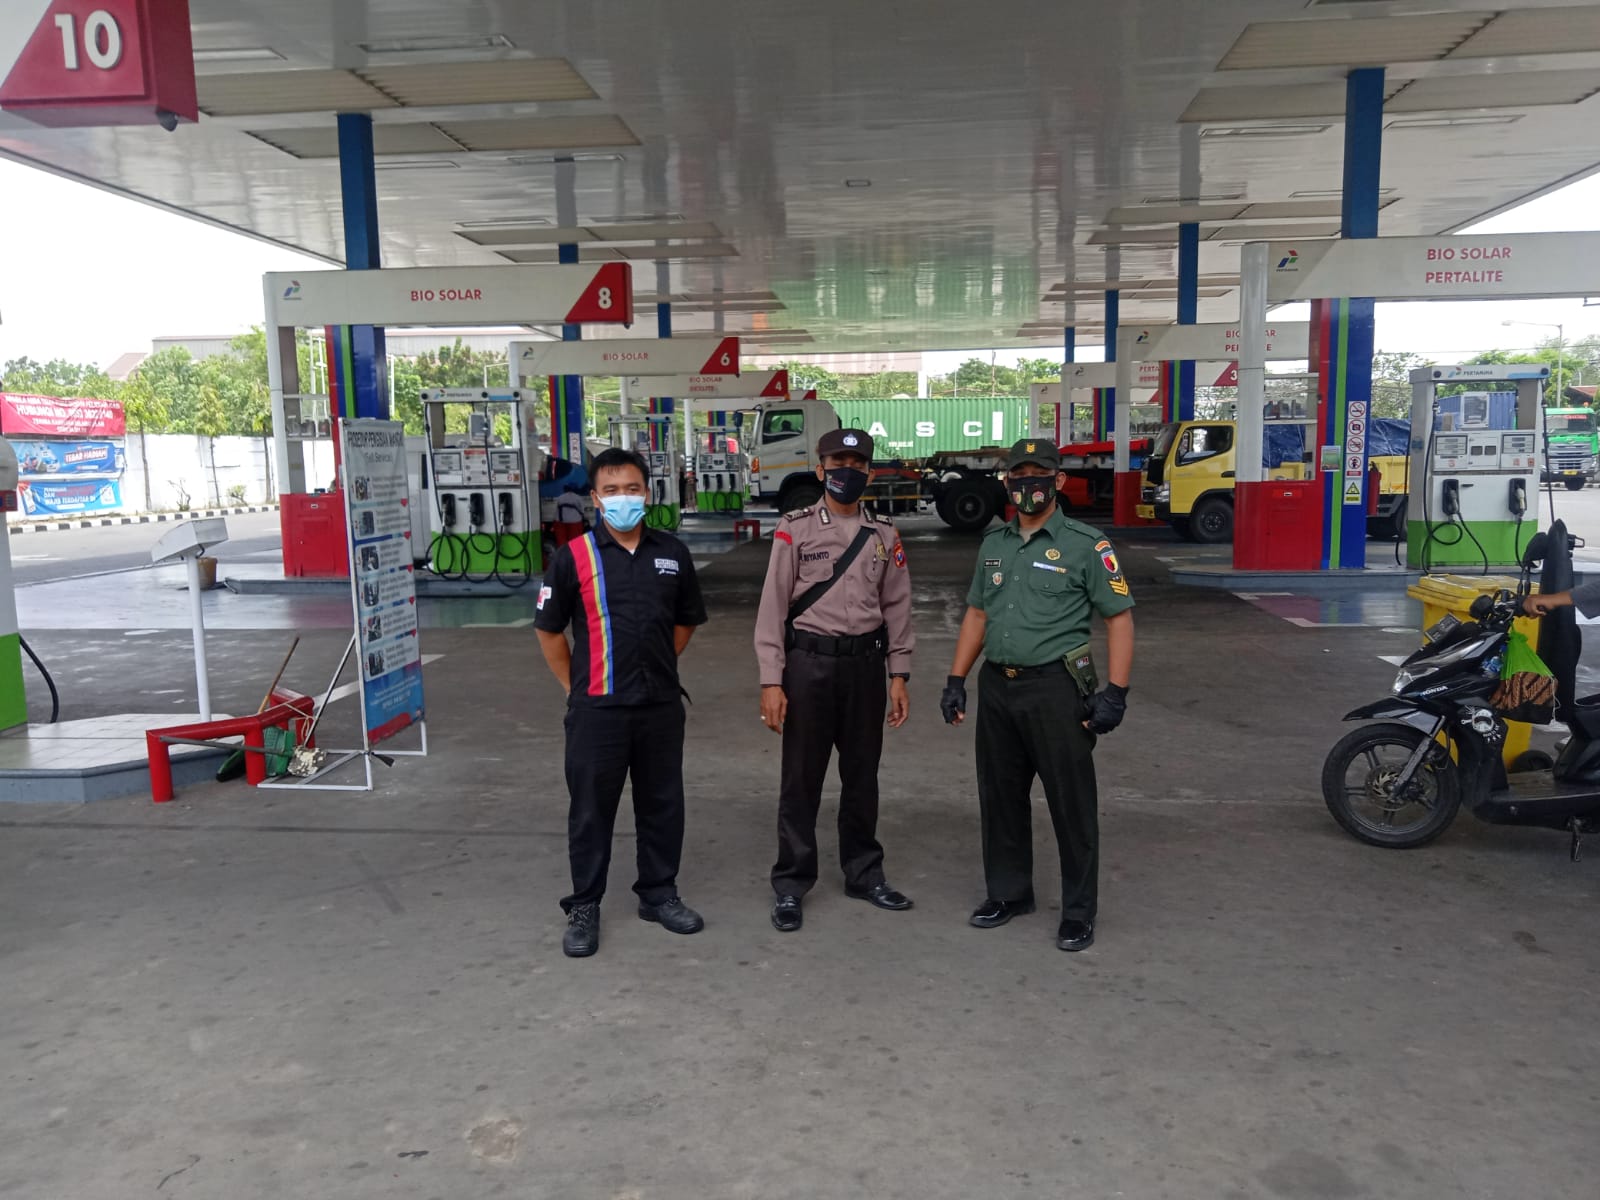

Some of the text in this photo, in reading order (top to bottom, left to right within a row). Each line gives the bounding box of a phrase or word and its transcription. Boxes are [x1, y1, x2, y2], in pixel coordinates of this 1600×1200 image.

[54, 10, 122, 71] 10
[1427, 247, 1511, 261] BIO SOLAR
[1425, 270, 1503, 283] PERTALITE
[411, 289, 482, 301] BIO SOLAR
[598, 287, 612, 310] 8
[603, 352, 649, 361] BIO SOLAR
[720, 352, 731, 366] 6
[1230, 370, 1238, 381] 3
[775, 382, 782, 391] 4
[1422, 685, 1449, 696] HONDA
